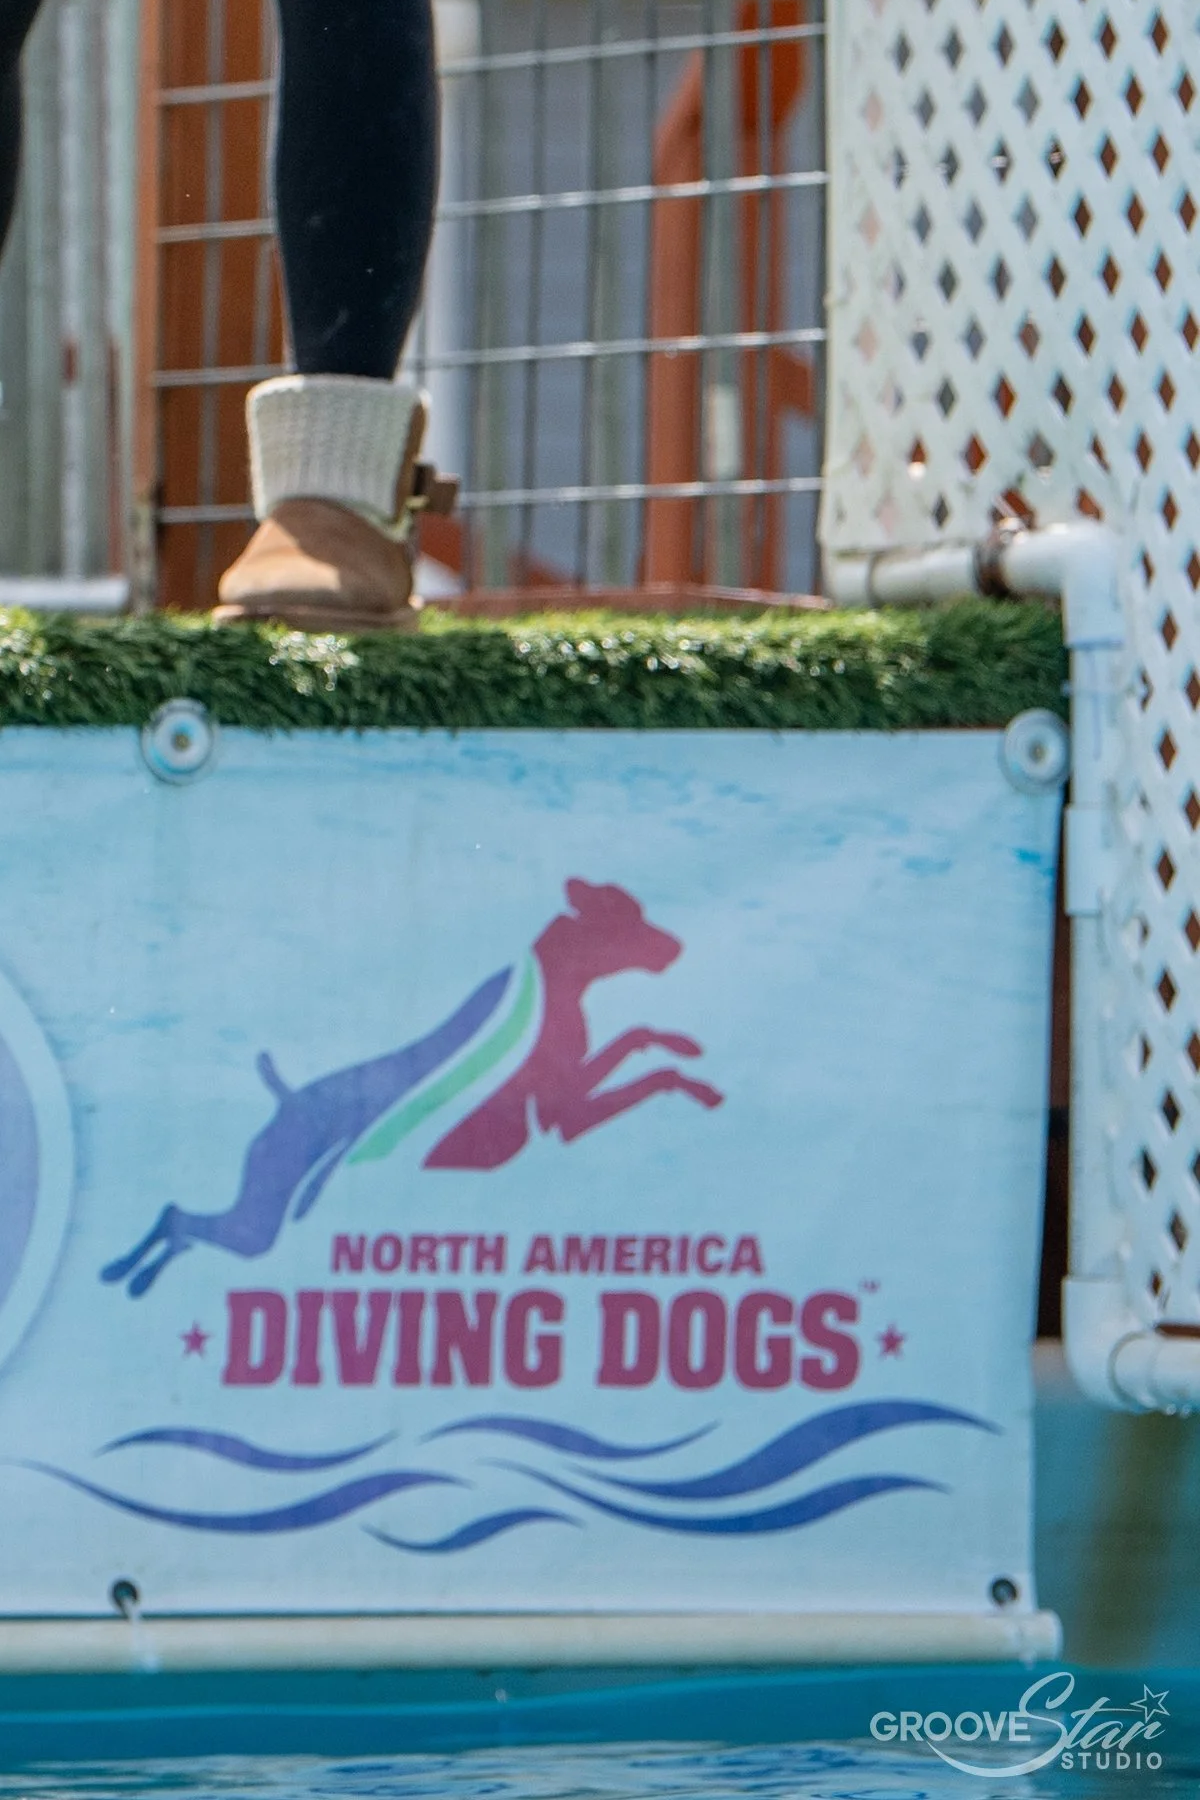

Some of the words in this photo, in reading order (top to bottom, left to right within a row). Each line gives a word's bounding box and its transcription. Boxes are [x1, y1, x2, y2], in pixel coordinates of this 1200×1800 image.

[330, 1235, 505, 1273] NORTH
[524, 1234, 765, 1276] AMERICA
[221, 1290, 566, 1387] DIVING
[594, 1290, 860, 1390] DOGS
